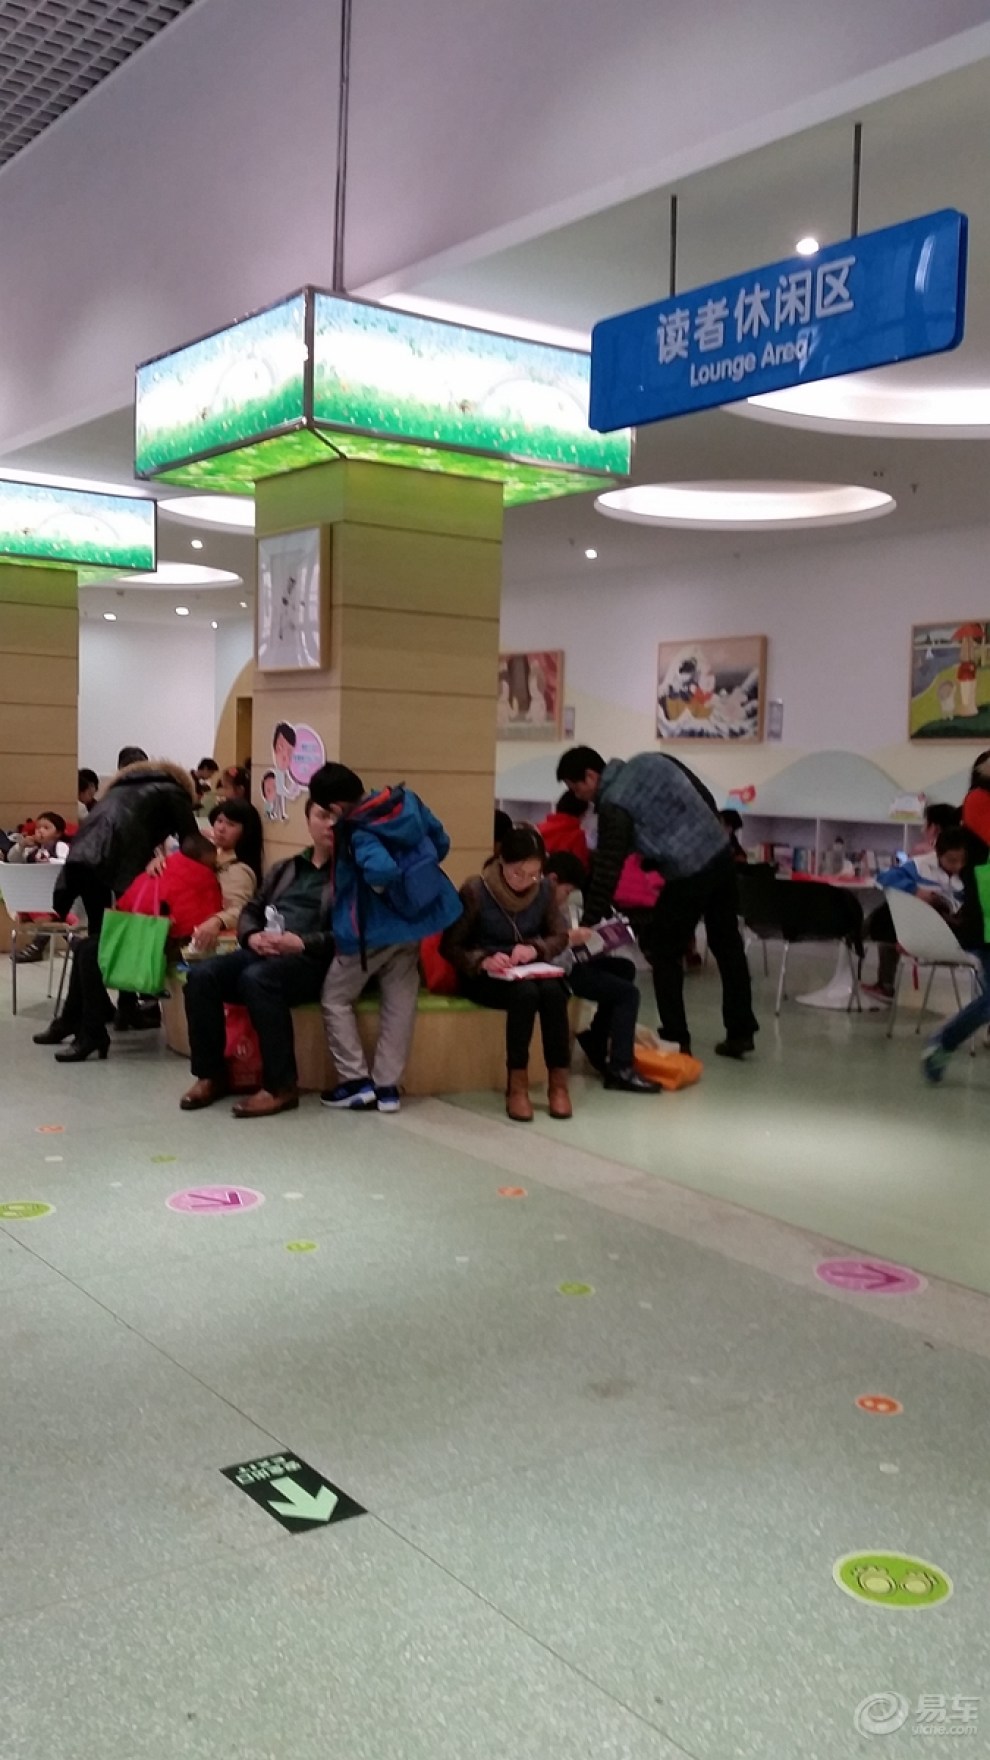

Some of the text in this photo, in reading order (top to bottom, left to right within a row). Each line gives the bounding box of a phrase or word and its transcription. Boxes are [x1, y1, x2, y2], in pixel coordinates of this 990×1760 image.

[656, 255, 856, 365] 读者休闲区
[690, 338, 808, 388] Lounge Area
